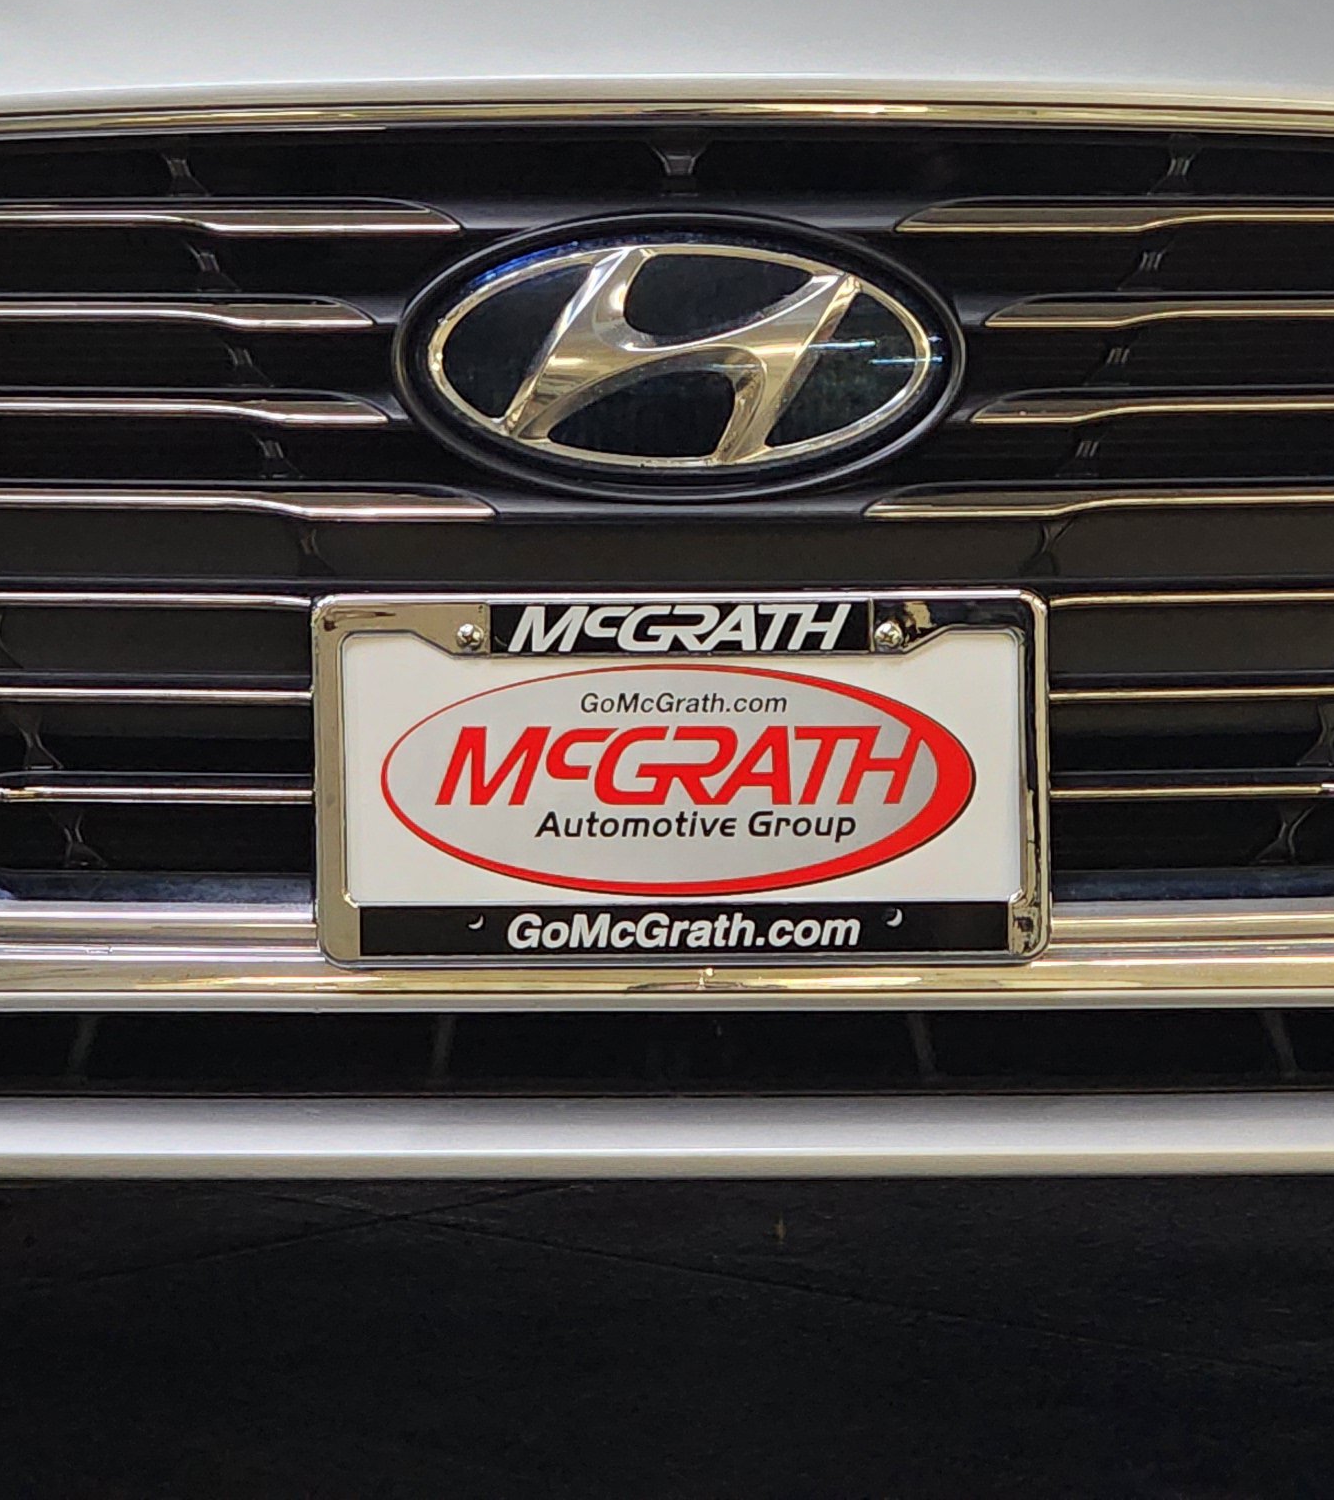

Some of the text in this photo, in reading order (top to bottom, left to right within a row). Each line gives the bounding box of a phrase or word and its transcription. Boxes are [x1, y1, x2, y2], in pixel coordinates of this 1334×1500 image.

[579, 691, 788, 714] GoMcGrath.com
[534, 809, 857, 843] Automotive Group
[506, 912, 861, 949] GoMcGrath.com
